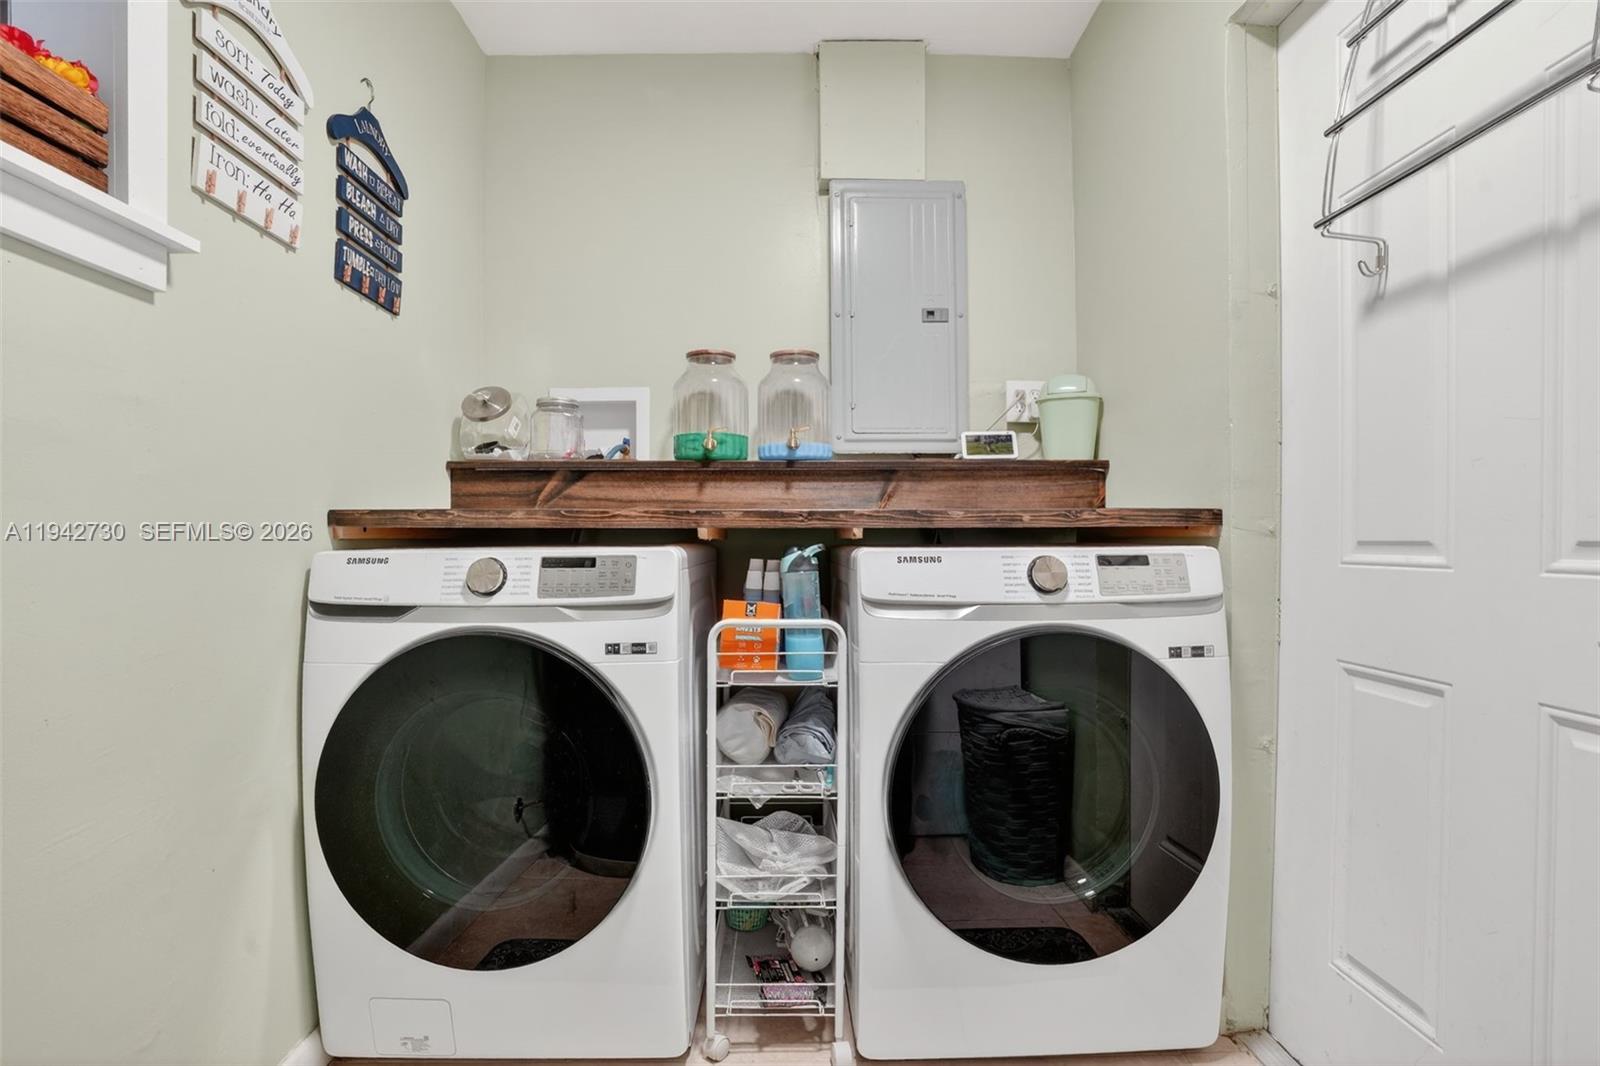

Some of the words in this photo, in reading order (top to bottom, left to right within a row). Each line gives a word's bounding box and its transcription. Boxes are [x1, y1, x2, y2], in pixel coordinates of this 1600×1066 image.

[209, 64, 258, 119] wash:
[265, 117, 300, 150] Later
[215, 29, 254, 75] sort:
[261, 67, 295, 110] Today
[205, 100, 240, 143] fold:
[241, 134, 302, 187] eventually
[208, 143, 250, 188] Iron:
[252, 180, 272, 203] Ha
[278, 197, 297, 220] Ha
[344, 146, 368, 184] WASH
[346, 557, 389, 565] SAMSUNG
[896, 555, 942, 564] SAMSUNG
